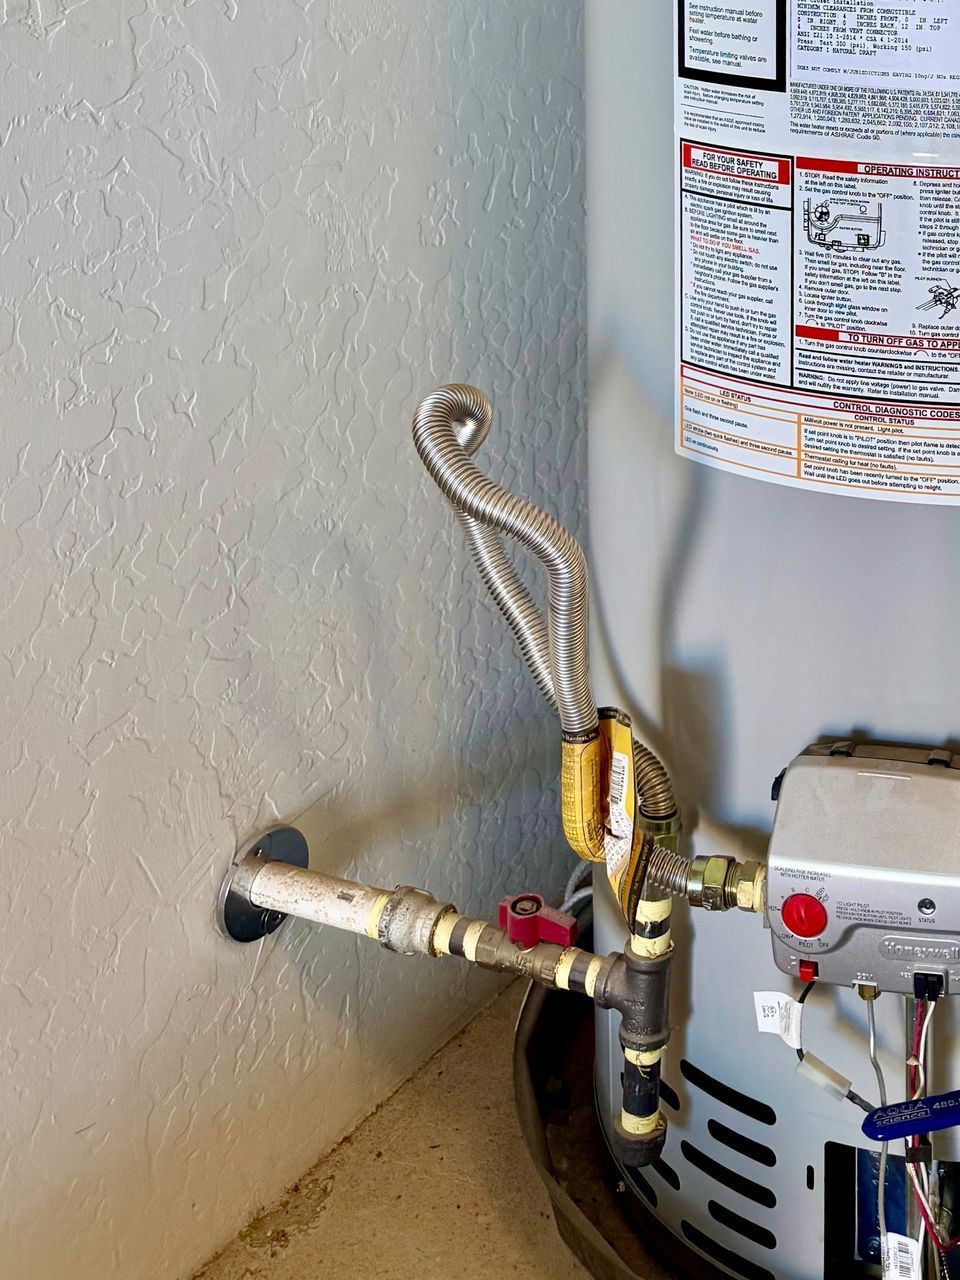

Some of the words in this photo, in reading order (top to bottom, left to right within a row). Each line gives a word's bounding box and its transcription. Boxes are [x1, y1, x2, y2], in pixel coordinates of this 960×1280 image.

[703, 152, 716, 161] FOR
[717, 154, 735, 165] YOUR
[736, 158, 763, 169] SAFETY
[692, 158, 708, 168] READ
[709, 162, 735, 173] BEFORE
[737, 166, 777, 180] OPERATING
[864, 166, 914, 177] OPERATING
[848, 333, 860, 343] TO
[862, 334, 885, 345] TURN
[887, 336, 904, 346] OFF
[906, 338, 925, 348] GAS
[926, 339, 939, 348] TO
[719, 390, 730, 398] LED
[731, 392, 752, 403] STATUS
[833, 402, 873, 414] CONTROL
[875, 405, 927, 418] DIAGNOSTIC
[929, 408, 960, 419] CODES
[855, 414, 885, 424] CONTROL
[887, 417, 915, 426] STATUS
[885, 942, 960, 959] Honeywell
[874, 1101, 927, 1120] AQUA
[876, 1112, 926, 1128] science
